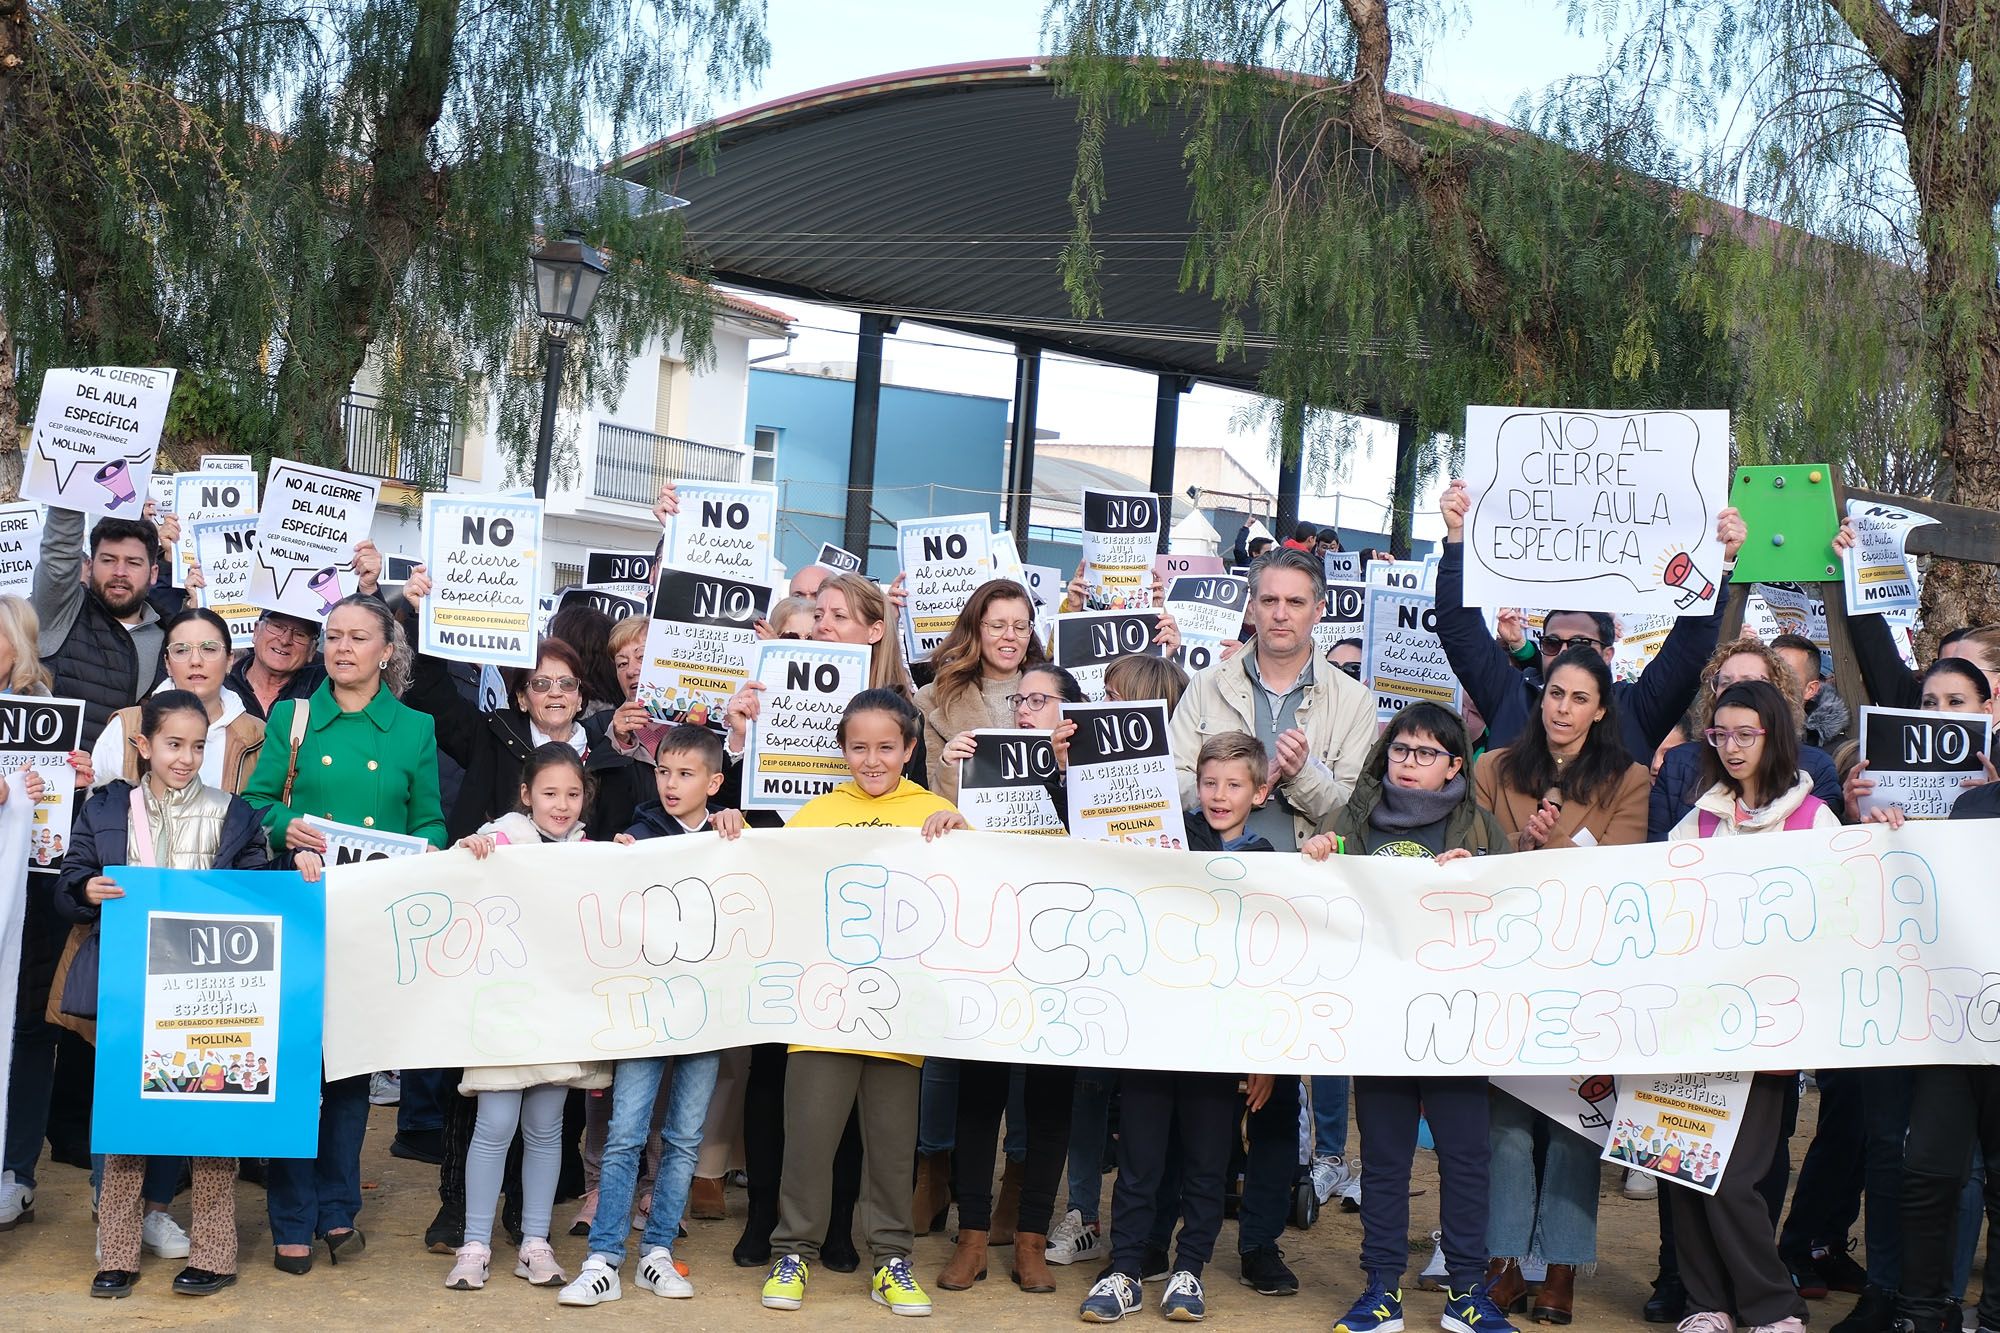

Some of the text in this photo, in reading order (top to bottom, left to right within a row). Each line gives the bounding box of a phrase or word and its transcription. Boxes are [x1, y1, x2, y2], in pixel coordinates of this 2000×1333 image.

[90, 367, 156, 389] AL CIERRE
[76, 384, 138, 409] DEL AULA
[64, 411, 139, 433] ESPECÍFICA
[48, 422, 128, 445] CEIP GERARDO FERNÁNDEZ
[1540, 416, 1663, 452] NO AL
[52, 437, 96, 456] MOLLINA
[1521, 452, 1637, 486] CIERRE
[202, 486, 240, 508] NO
[286, 478, 362, 502] NO AL CIERRE
[292, 500, 346, 521] DEL AULA
[702, 500, 750, 530] NO
[1106, 500, 1150, 528] NO
[1508, 489, 1671, 526] DEL AULA
[1864, 506, 1908, 520] NO
[282, 518, 348, 544] ESPECÍFICA
[462, 516, 514, 547] NO
[1870, 522, 1898, 530] cierre
[267, 533, 338, 554] CEIP GERARDO FERNÁNDEZ
[688, 532, 754, 550] Al cierre
[924, 534, 968, 562] NO
[1102, 536, 1136, 544] CIERRE
[1494, 522, 1642, 566] ESPECÍFICA
[1862, 534, 1894, 546] del Aula
[213, 559, 230, 570] Al
[270, 547, 310, 564] MOLLINA
[448, 550, 520, 568] Al cierre
[686, 552, 753, 568] del Aula
[1862, 550, 1898, 564] Específica
[611, 557, 650, 580] NO
[916, 566, 976, 579] Al cierre
[1167, 560, 1190, 572] NO
[1333, 560, 1352, 571] NO
[216, 573, 236, 584] del
[446, 568, 518, 586] del Aula
[1386, 573, 1418, 589] NO
[917, 582, 976, 595] del Aula
[1194, 580, 1239, 604] NO
[1864, 584, 1911, 600] MOLLINA
[441, 588, 524, 608] Específica
[693, 582, 755, 622] NO
[453, 614, 486, 623] GERARDO
[486, 616, 526, 626] FERNÁNDEZ
[1398, 605, 1438, 633] NO
[439, 630, 522, 651] MOLLINA
[664, 624, 756, 645] AL CIERRE DEL
[1090, 618, 1149, 658] NO
[1386, 632, 1402, 644] Al
[692, 639, 724, 652] AULA
[670, 650, 745, 668] ESPECÍFICA
[1384, 646, 1446, 665] del Aula
[656, 658, 746, 676] CEIP GERARDO FERNÁNDEZ
[1380, 662, 1450, 682] Específica
[682, 676, 728, 690] MOLLINA
[786, 661, 840, 693] NO
[1390, 684, 1418, 693] GERARDO
[1418, 688, 1452, 698] FERNÁNDEZ
[772, 696, 844, 714] Al cierre
[0, 708, 64, 745] NO
[771, 713, 838, 732] del Aula
[1094, 712, 1153, 756] NO
[1904, 724, 1970, 764] NO
[40, 755, 66, 766] DEL
[778, 760, 812, 768] GERARDO
[1000, 740, 1055, 780] NO
[1080, 760, 1166, 781] AL CIERRE DEL
[764, 778, 842, 795] MOLLIN
[1110, 777, 1140, 790] AULA
[1879, 776, 1894, 788] AL
[1899, 776, 1944, 788] CIERRE
[976, 792, 992, 804] AL
[995, 790, 1042, 802] CIERRE
[1092, 786, 1162, 805] ESPECÍFICA
[1908, 790, 1942, 801] AULA
[1007, 802, 1040, 815] AULA
[1098, 806, 1127, 814] GERARDO
[1128, 801, 1166, 811] FERNÁNDEZ
[985, 812, 1062, 828] ESPECÍFICA
[1110, 820, 1155, 832] MOLLINA
[384, 892, 528, 985] POR
[578, 873, 774, 969] UNA
[190, 925, 258, 966] NO
[162, 976, 266, 990] AL CIERRE DEL
[198, 990, 232, 1002] AULA
[174, 1000, 257, 1016] ESPECÍFICA
[178, 1019, 214, 1027] GERARDO
[216, 1016, 259, 1026] FERNÁNDEZ
[470, 982, 541, 1058] E
[1204, 990, 1354, 1066] POR
[1404, 974, 1804, 1066] NUESTROS
[191, 1034, 242, 1046] MOLLINA
[1674, 1073, 1707, 1089] AULA
[1652, 1080, 1727, 1106] ESPECÍFICA
[1638, 1092, 1726, 1118] CEIP GERARDO FERNÁNDEZ
[1662, 1115, 1706, 1132] MOLLINA
